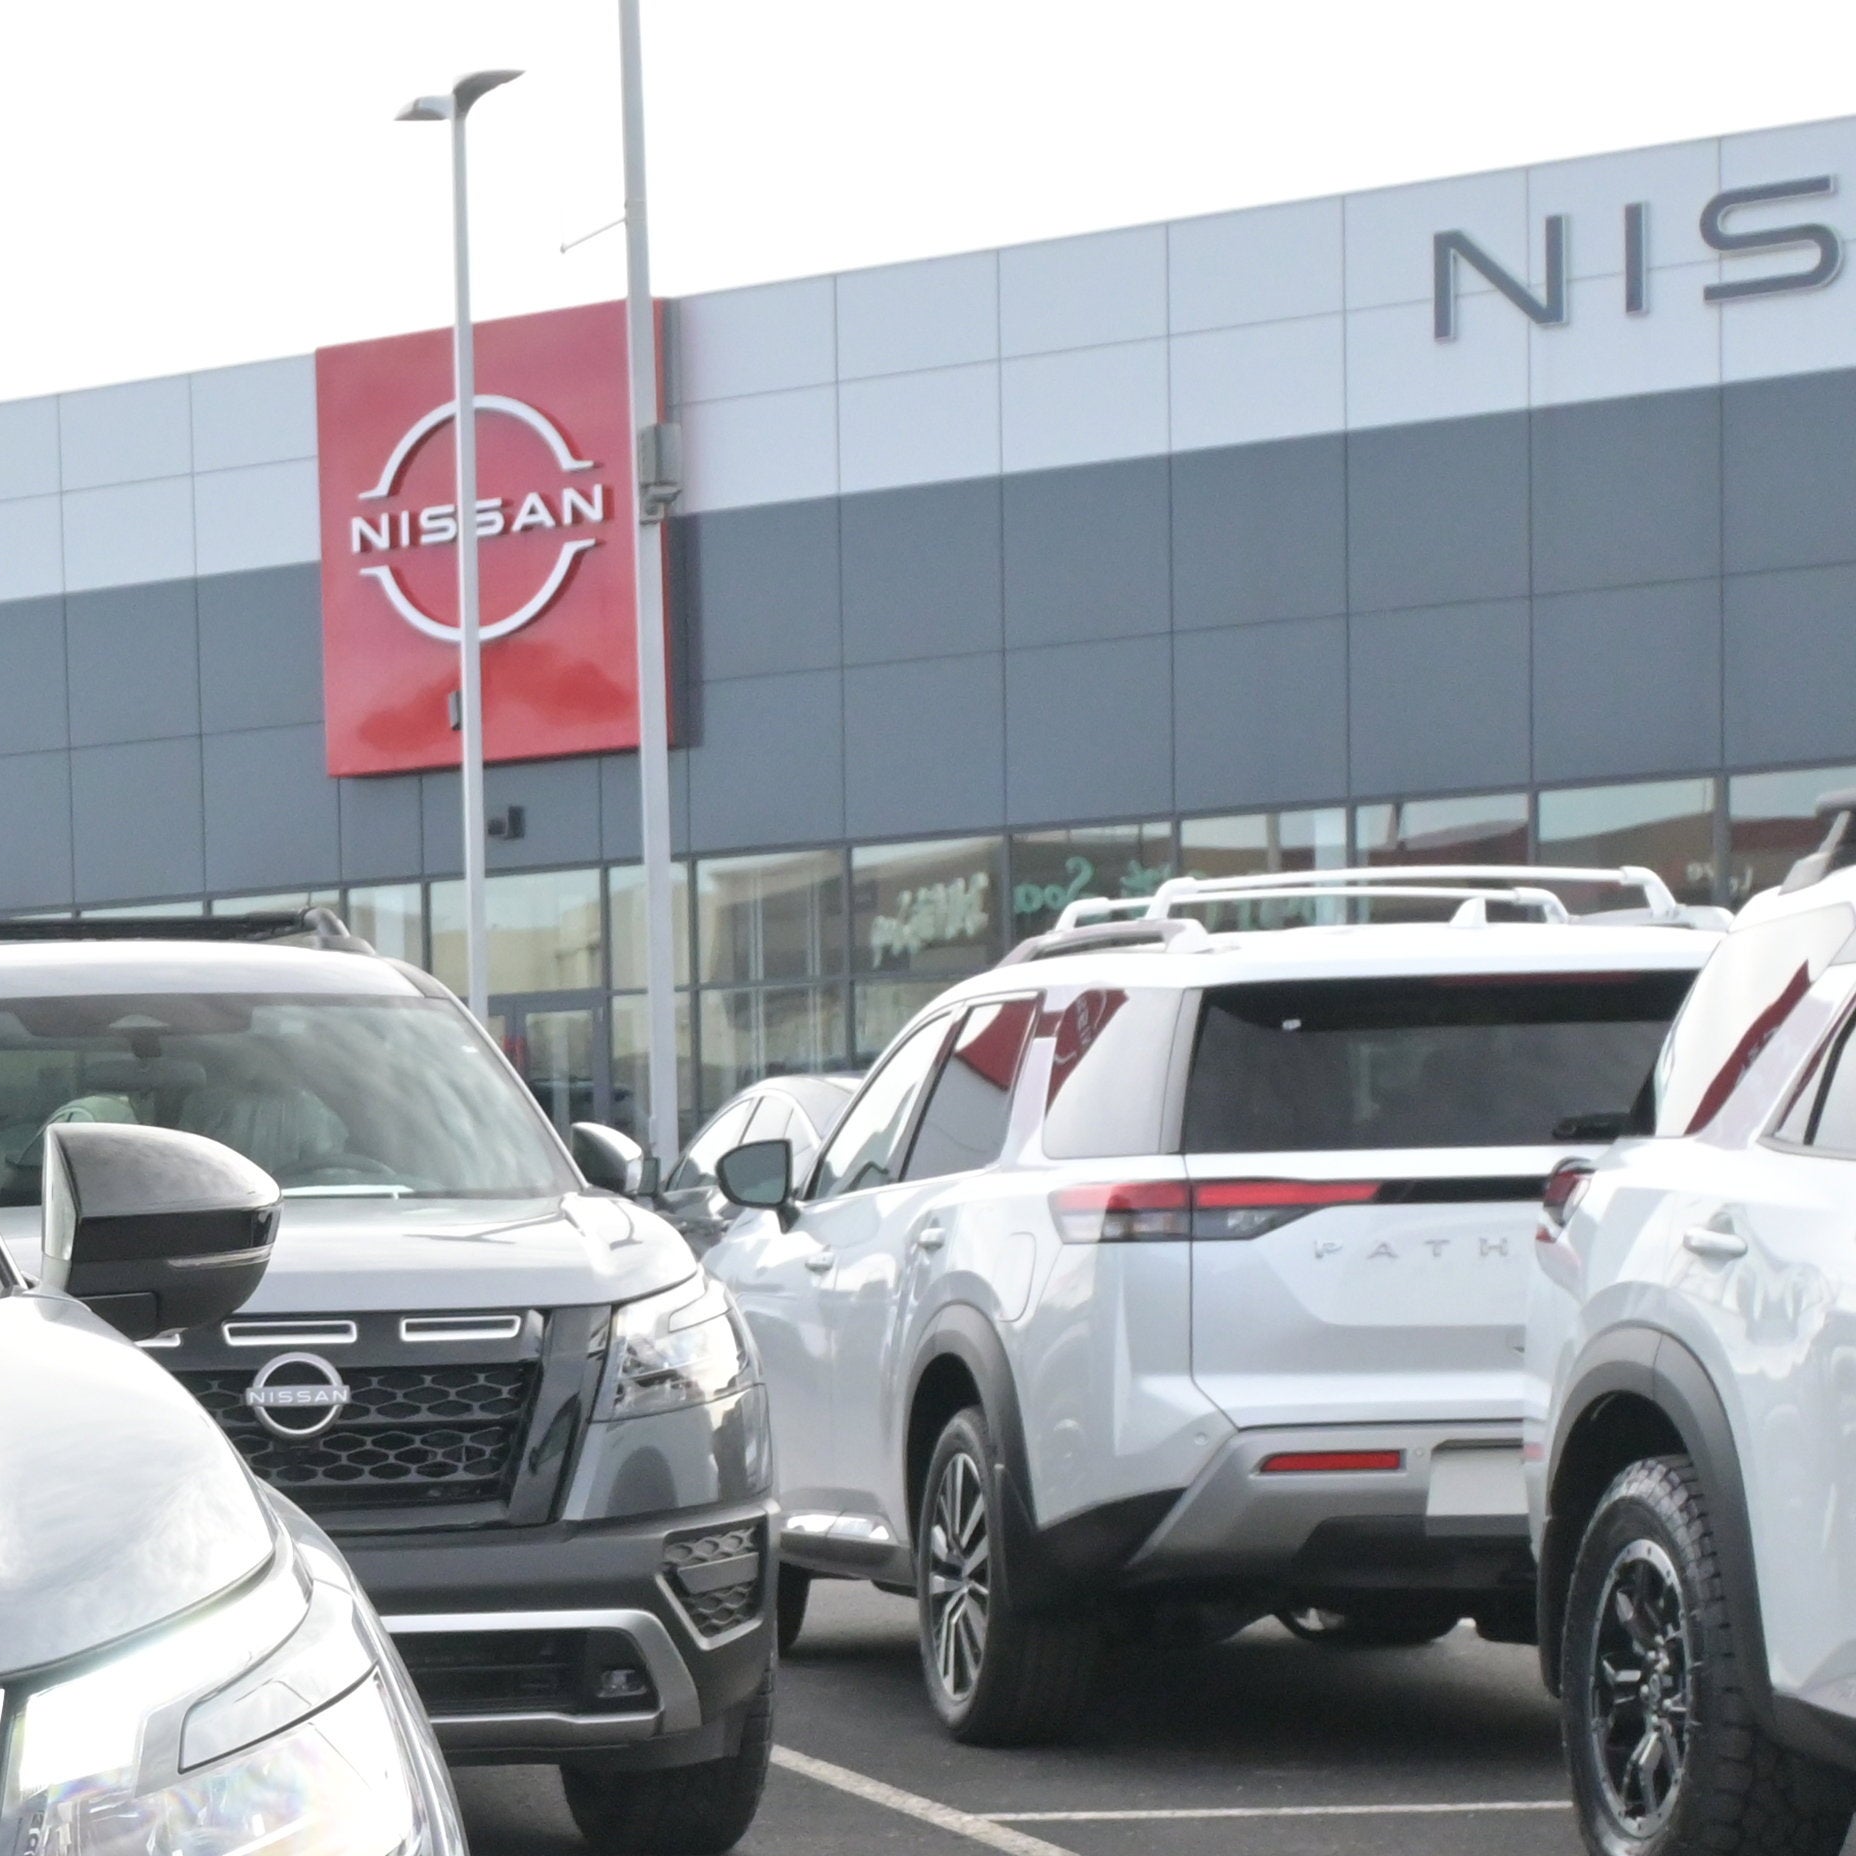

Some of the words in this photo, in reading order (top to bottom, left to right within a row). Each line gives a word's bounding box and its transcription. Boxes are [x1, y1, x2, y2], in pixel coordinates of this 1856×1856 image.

[1433, 174, 1845, 342] NIS
[351, 483, 605, 554] NISSAN
[249, 1389, 347, 1403] NISSAN
